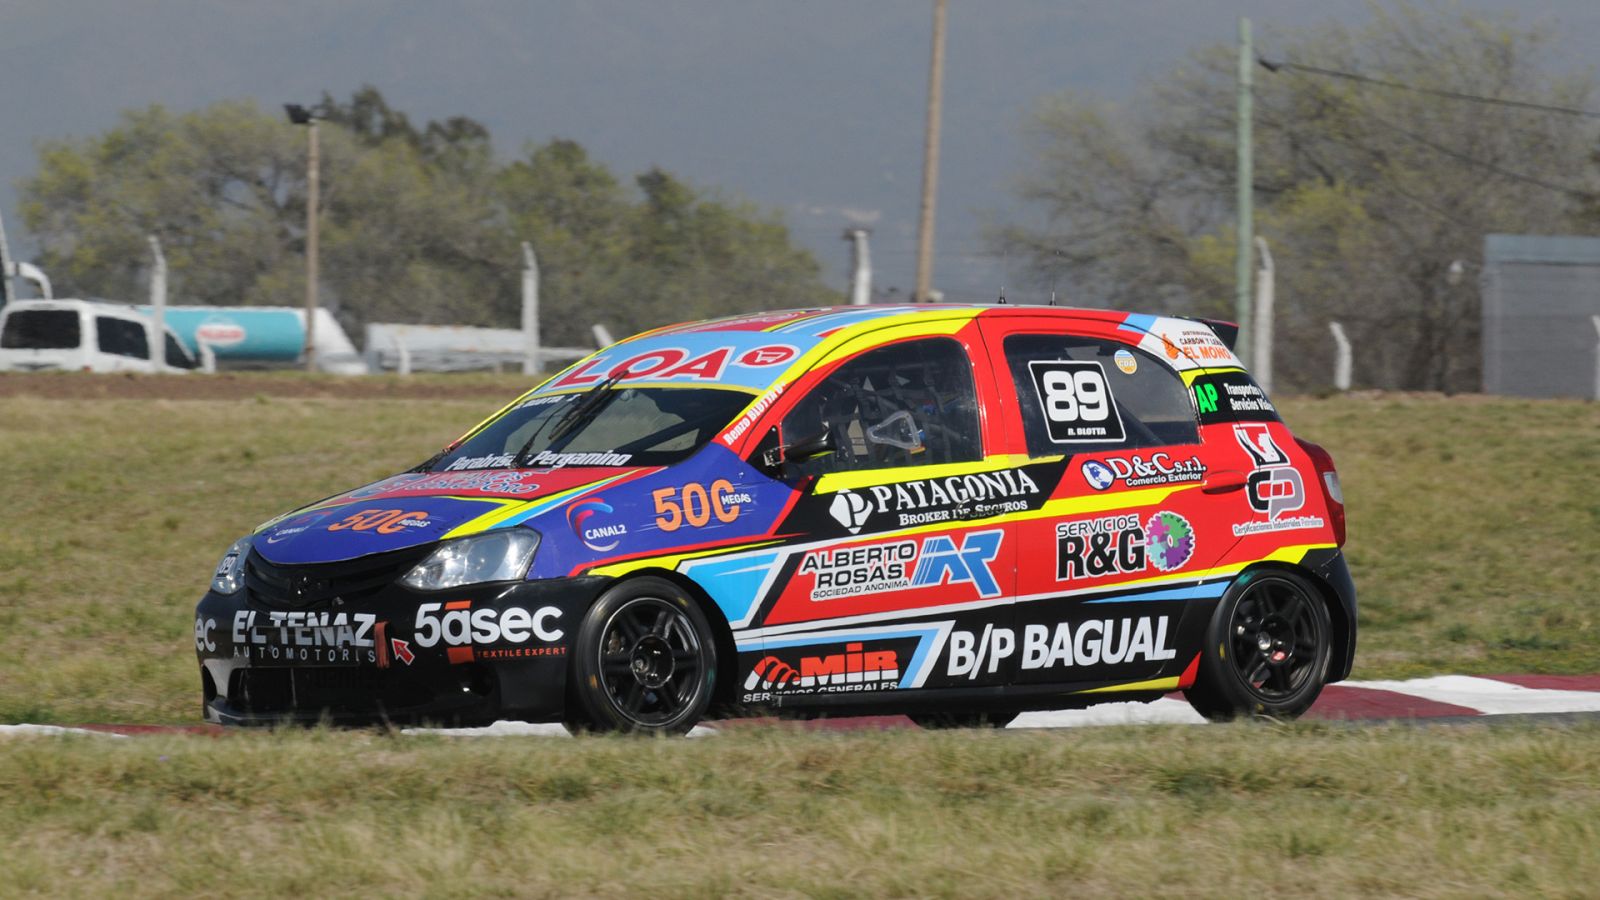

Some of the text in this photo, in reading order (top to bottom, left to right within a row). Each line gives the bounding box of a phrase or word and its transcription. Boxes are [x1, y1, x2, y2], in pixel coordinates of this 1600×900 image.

[1183, 346, 1232, 360] EL MONO
[549, 346, 736, 388] LOA
[1043, 370, 1109, 422] 89
[1195, 383, 1219, 414] AP
[722, 416, 752, 446] Renzo
[1076, 427, 1107, 436] BLOTTA
[527, 449, 633, 468] Pergamino
[1105, 452, 1176, 480] D&C
[869, 468, 1040, 513] PATAGONIA
[1125, 471, 1202, 487] Comercio Exterior
[721, 493, 752, 506] MEGAS
[584, 523, 627, 541] CANAL2
[1057, 515, 1139, 538] SERVICIOS
[217, 555, 237, 575] 89
[802, 543, 916, 573] ALBERTO
[1057, 528, 1146, 580] R&G
[812, 580, 909, 600] SOCIEDAD ANONIMA
[817, 563, 904, 590] ROSAS
[232, 609, 377, 648] EL TENAZ
[477, 647, 566, 659] TEXTILE EXPERT
[946, 615, 1177, 681] B/P BAGUAL
